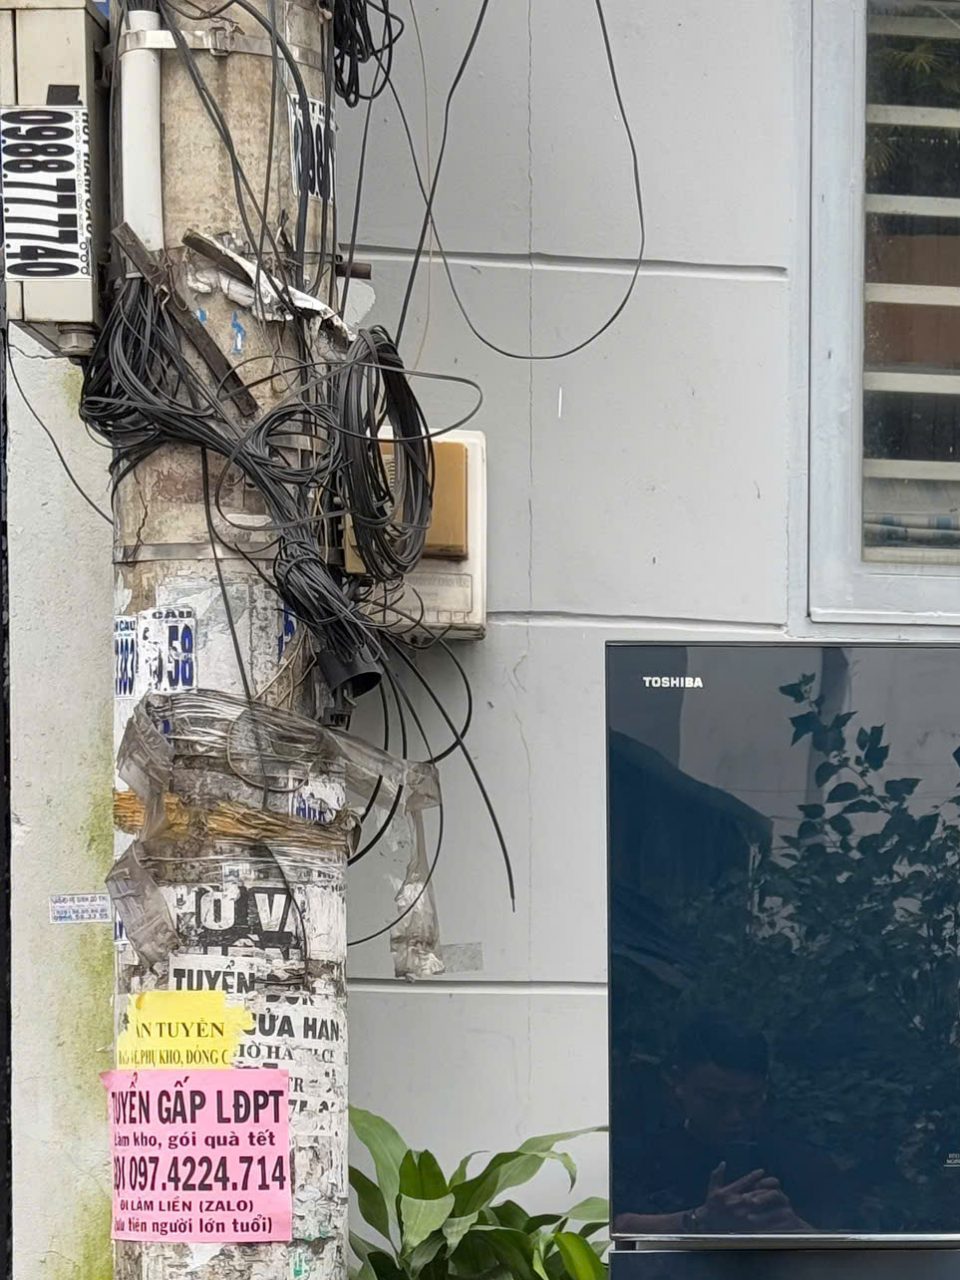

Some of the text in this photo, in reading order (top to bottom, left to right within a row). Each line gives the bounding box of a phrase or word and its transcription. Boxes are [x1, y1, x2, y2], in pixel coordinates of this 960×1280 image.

[642, 676, 703, 688] TOSHIBA
[157, 1076, 207, 1125] GẤP
[216, 1090, 284, 1124] LĐPT
[133, 1132, 162, 1149] kho,
[168, 1131, 196, 1150] gói
[204, 1131, 240, 1149] quà
[248, 1129, 276, 1147] tết
[129, 1155, 287, 1192] 097.4224.714
[131, 1197, 154, 1212] LÀM
[199, 1200, 254, 1213] (ZALO)
[152, 1217, 193, 1236] người
[199, 1218, 225, 1233] lớn
[232, 1214, 273, 1234] tuổi)
